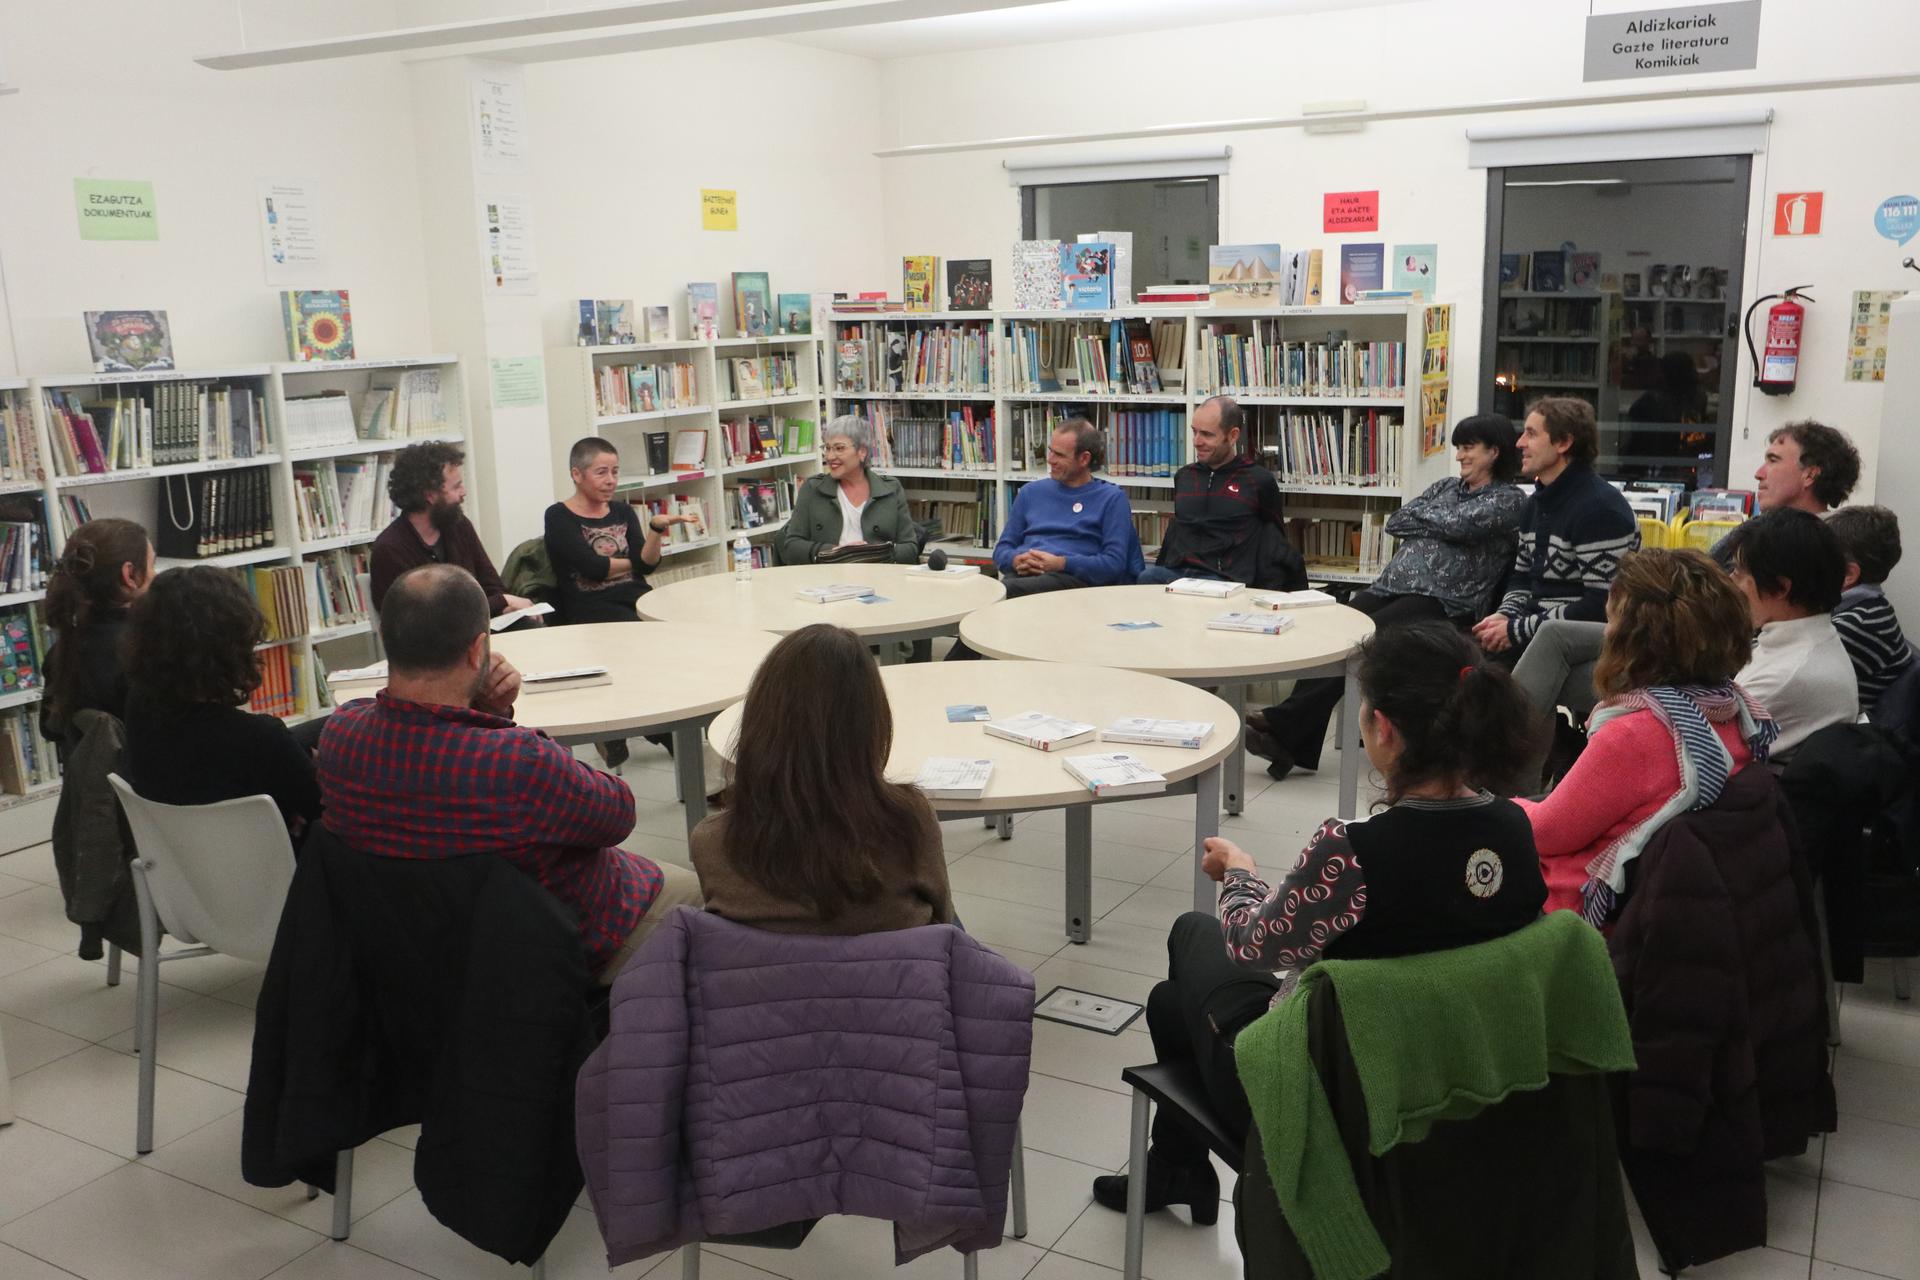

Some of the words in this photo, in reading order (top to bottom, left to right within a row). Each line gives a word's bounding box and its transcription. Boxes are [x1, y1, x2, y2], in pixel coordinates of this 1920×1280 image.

[1626, 13, 1717, 34] Aldizkariak
[1612, 41, 1655, 54] Gazte
[1661, 35, 1729, 50] literatura
[1635, 53, 1700, 69] Komikiak
[89, 193, 142, 205] EZAGUTZA
[83, 208, 152, 218] DOKUMENTUAK
[1883, 206, 1900, 218] 116
[1903, 205, 1917, 216] 111
[1328, 215, 1374, 224] ALDIZKARIAK
[1133, 342, 1151, 358] 101
